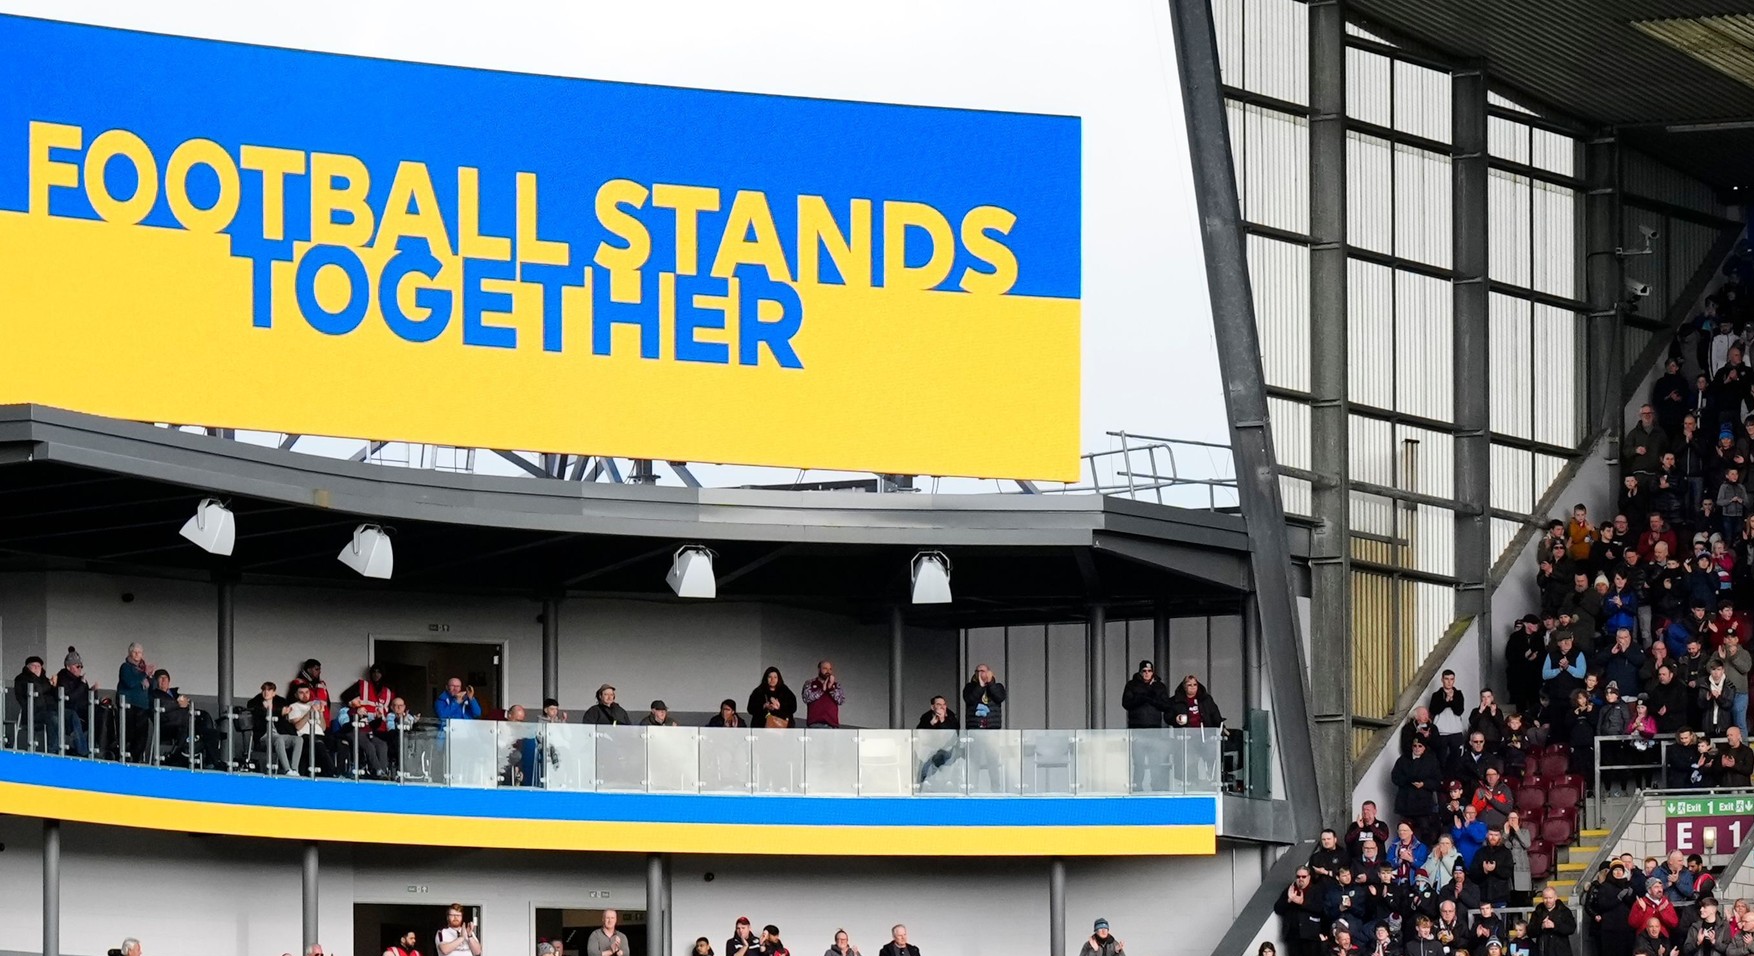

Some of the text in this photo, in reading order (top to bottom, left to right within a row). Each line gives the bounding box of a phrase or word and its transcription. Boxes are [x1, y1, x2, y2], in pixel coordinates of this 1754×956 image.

[28, 120, 1019, 298] FOOTBALL STANDS
[229, 232, 805, 370] TOGETHER
[1677, 821, 1741, 849] E 1
[1686, 801, 1734, 814] Exit 1 Exit
